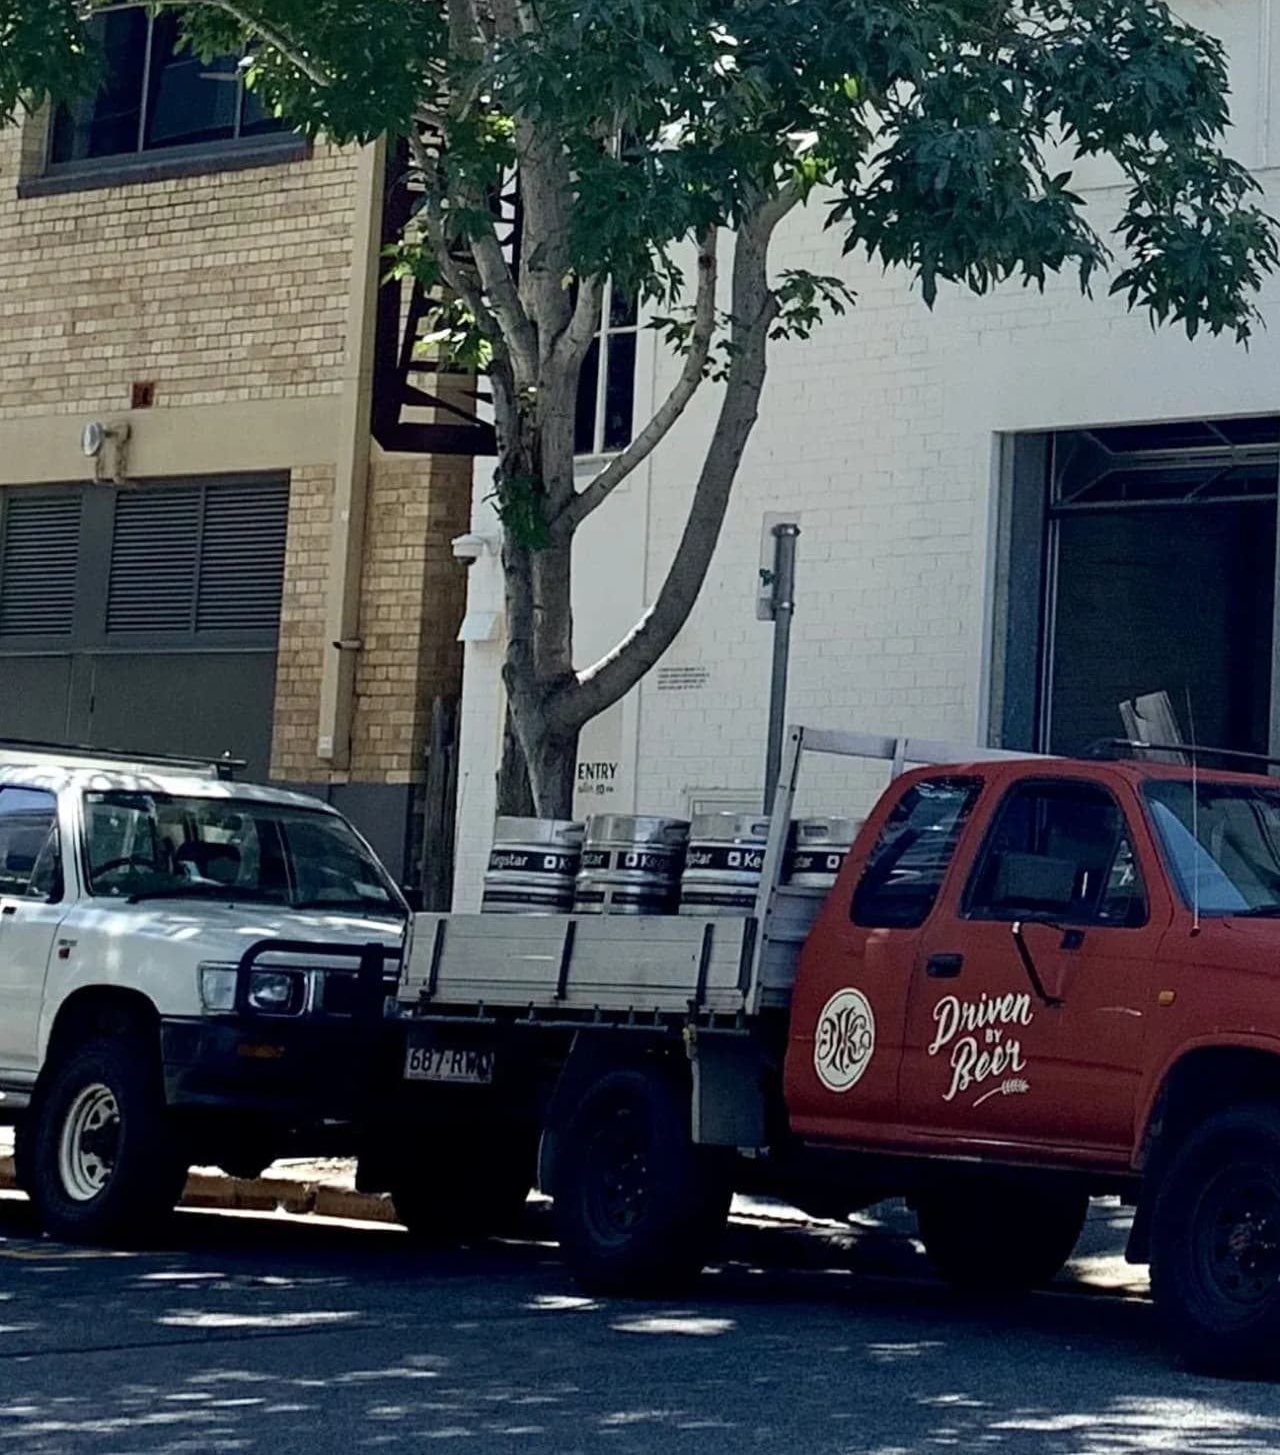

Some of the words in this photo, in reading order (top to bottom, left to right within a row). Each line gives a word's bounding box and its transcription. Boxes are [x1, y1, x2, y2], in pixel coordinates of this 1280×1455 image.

[578, 762, 618, 780] ENTRY
[928, 993, 1034, 1056] Driven
[985, 1028, 1003, 1044] BY
[942, 1037, 1027, 1102] Beer
